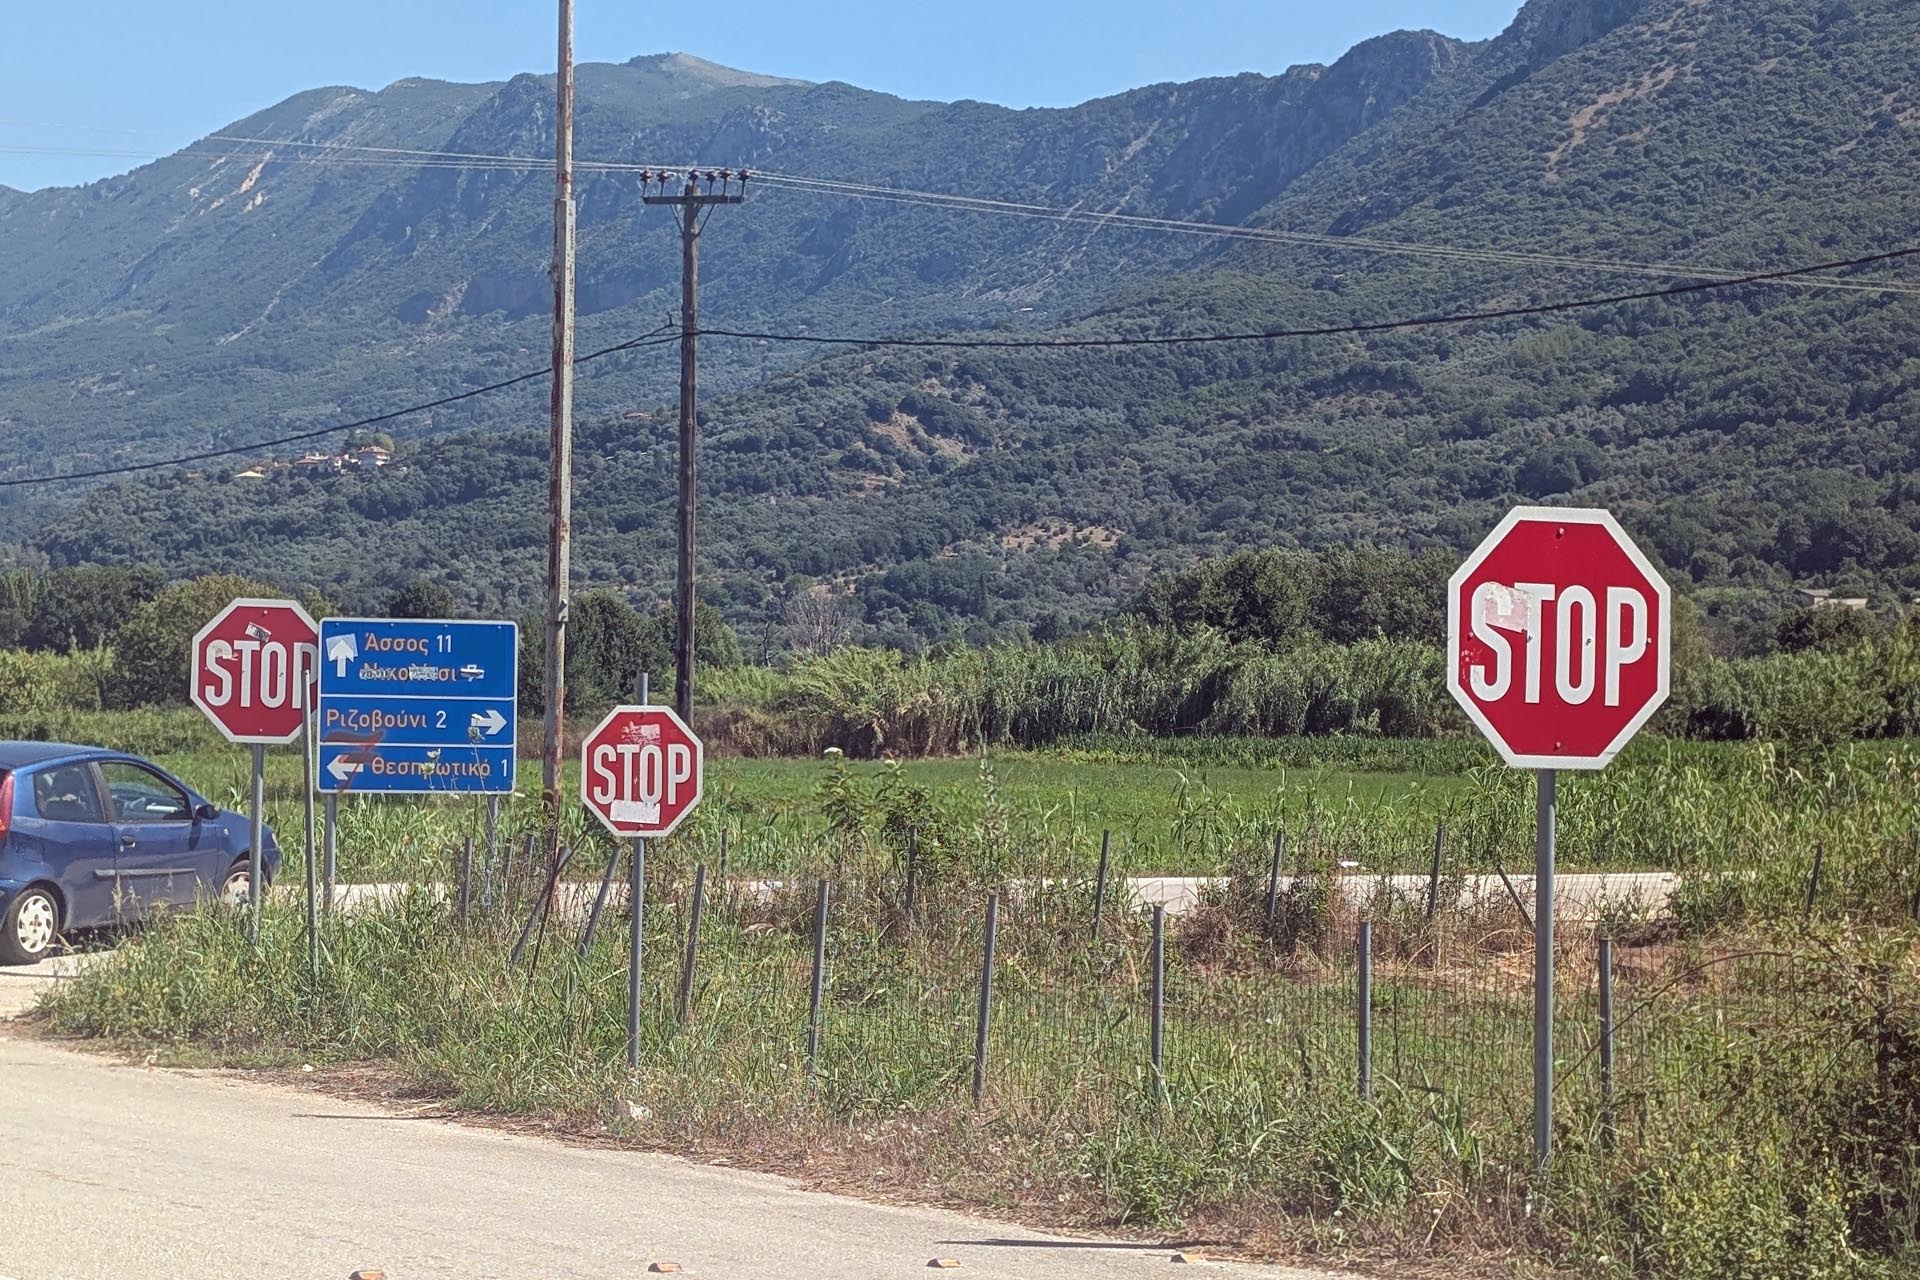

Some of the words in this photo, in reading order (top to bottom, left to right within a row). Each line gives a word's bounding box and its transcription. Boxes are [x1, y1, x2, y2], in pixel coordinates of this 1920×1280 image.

[364, 632, 429, 656] Άσσος
[436, 634, 452, 653] 11
[1470, 581, 1648, 707] STOP
[204, 639, 318, 709] STOP
[326, 709, 427, 732] Ριζοβούνι
[435, 710, 447, 729] 2
[501, 759, 508, 777] 1
[593, 744, 692, 805] STOP
